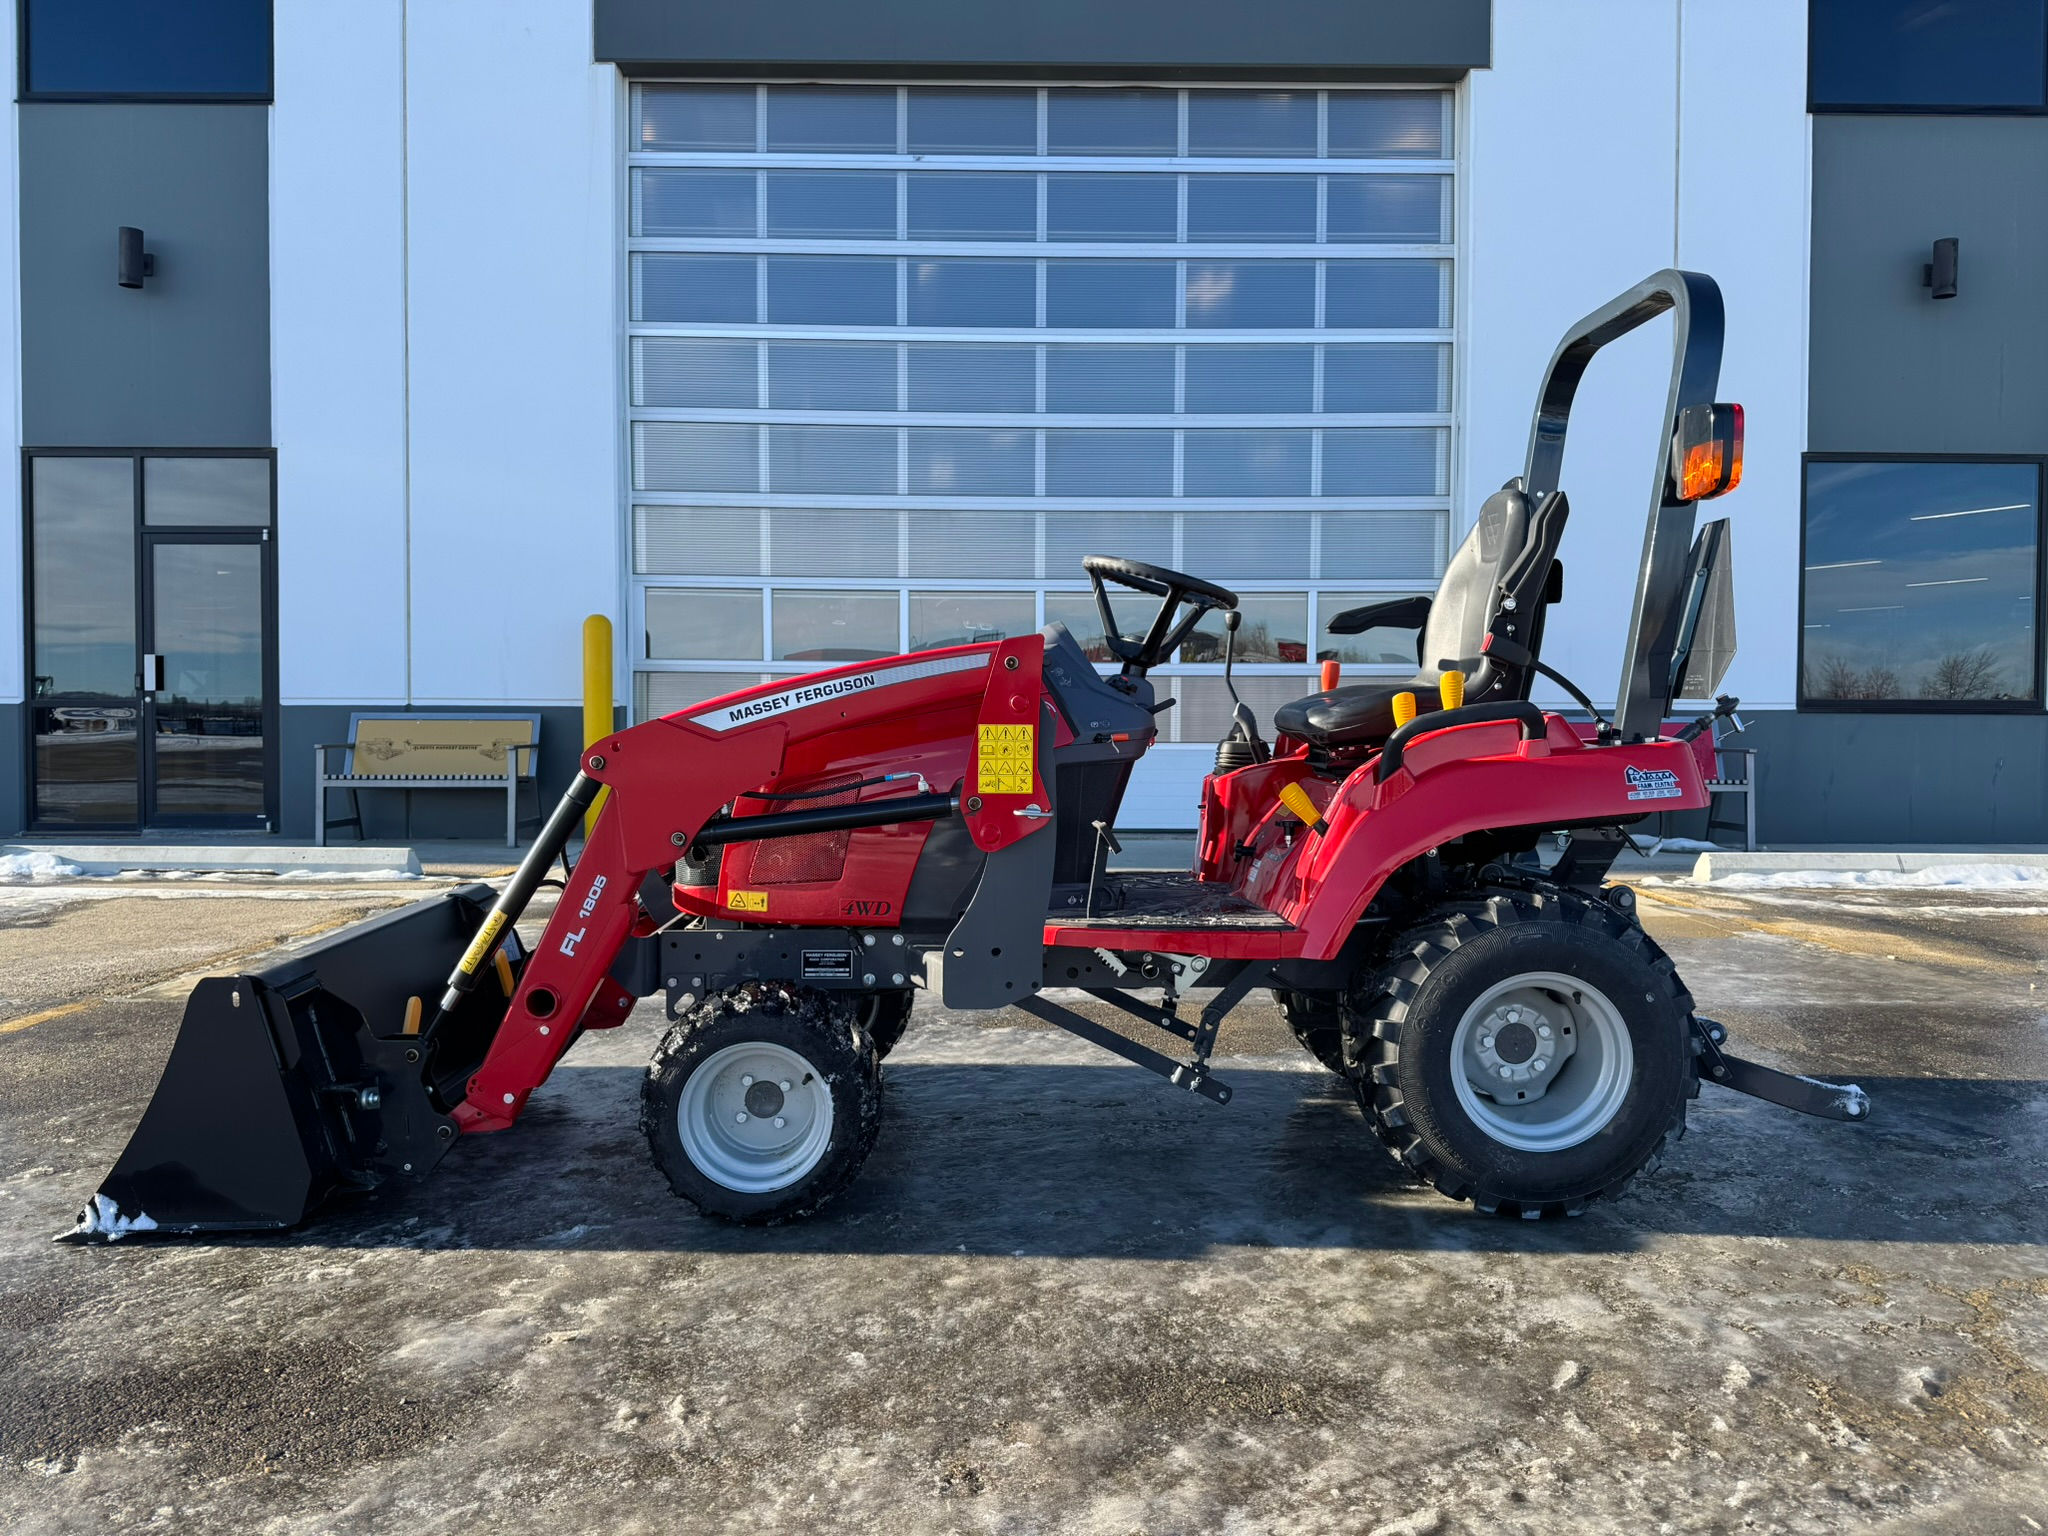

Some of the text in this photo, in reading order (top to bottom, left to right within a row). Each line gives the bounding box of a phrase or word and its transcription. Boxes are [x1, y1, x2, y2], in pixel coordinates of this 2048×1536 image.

[728, 674, 876, 722] MASSEY FERGUSON
[559, 874, 607, 957] FL 1805
[841, 900, 891, 916] 4WD
